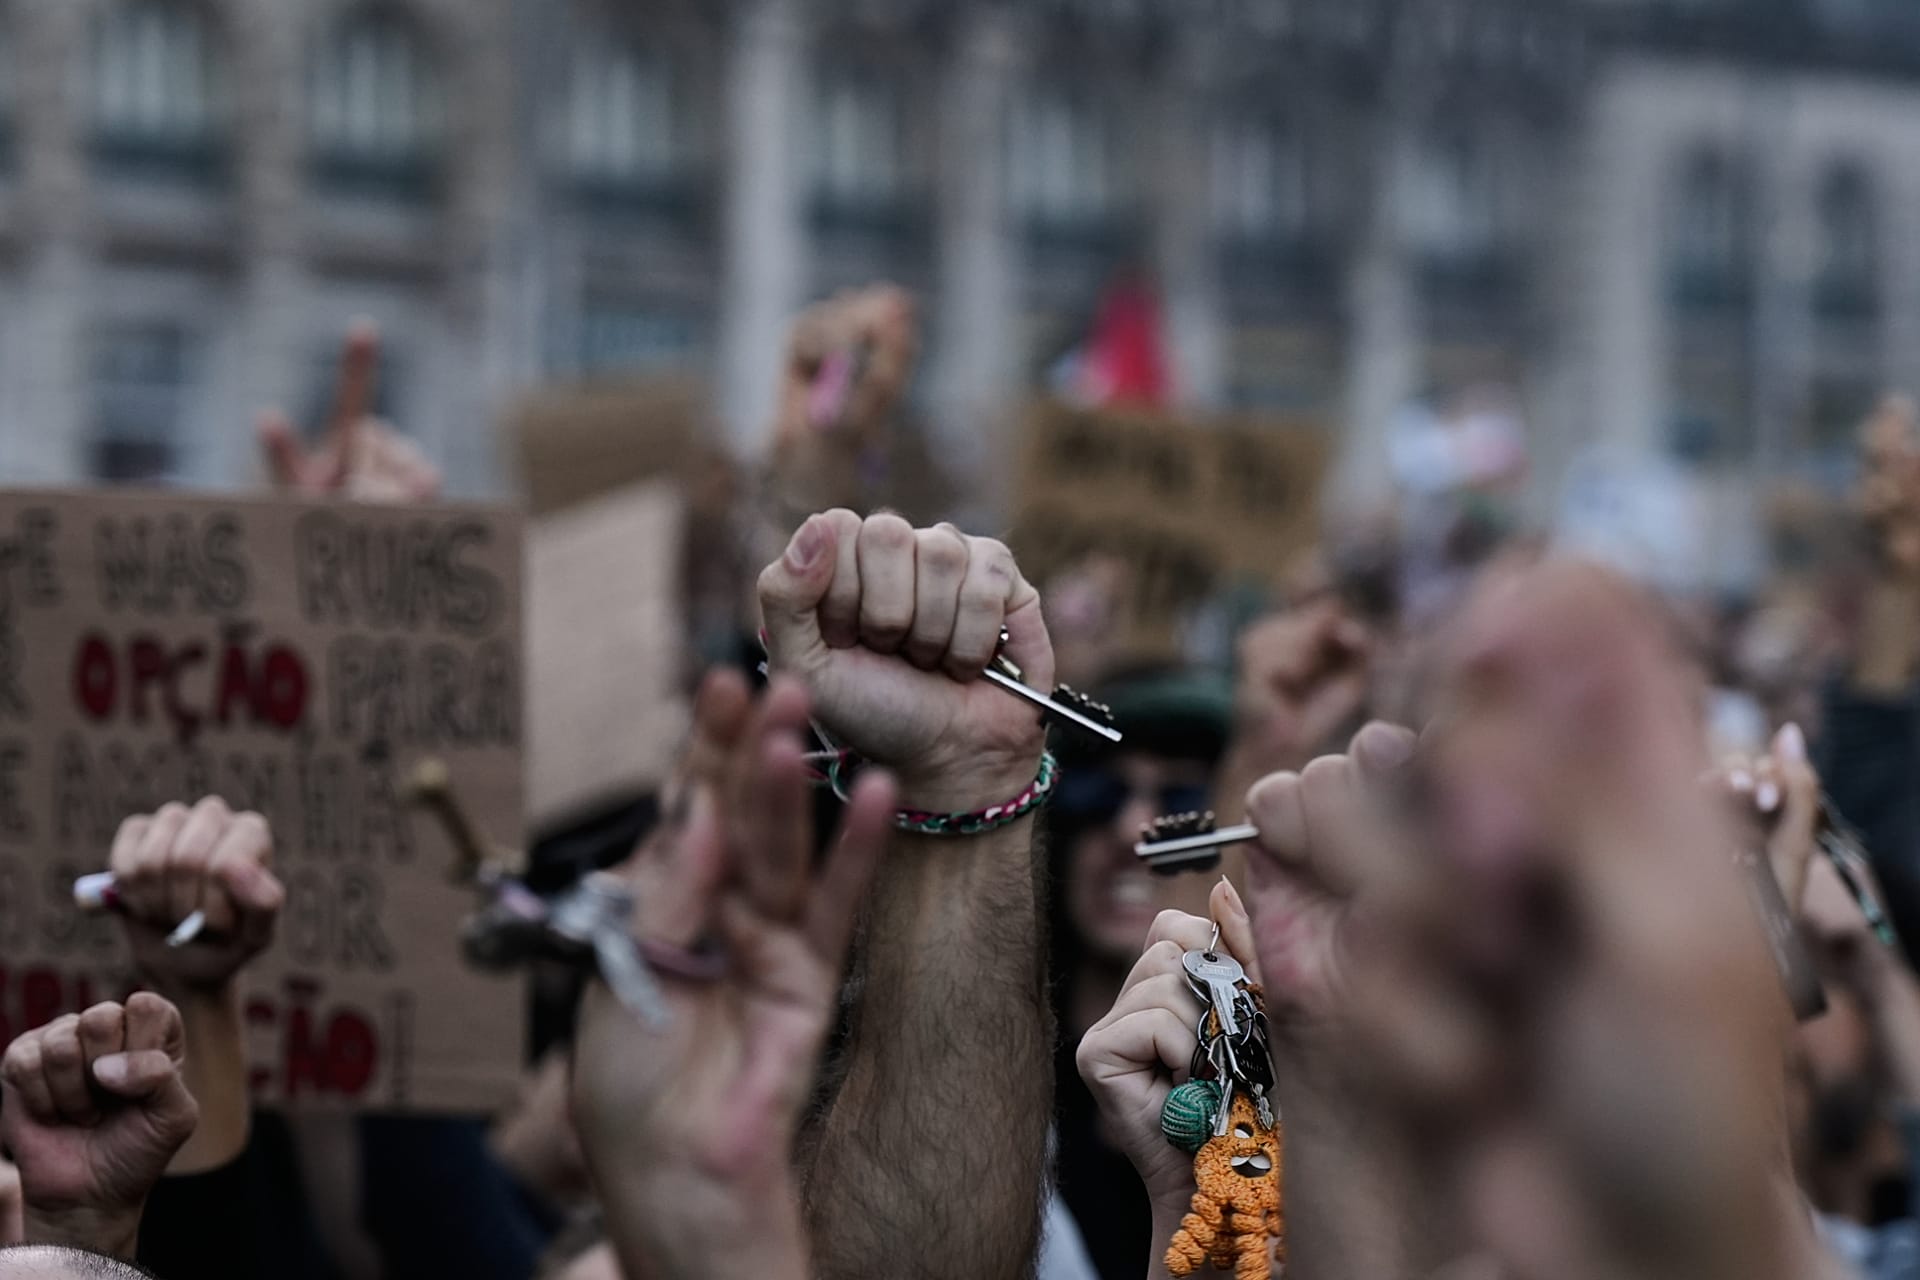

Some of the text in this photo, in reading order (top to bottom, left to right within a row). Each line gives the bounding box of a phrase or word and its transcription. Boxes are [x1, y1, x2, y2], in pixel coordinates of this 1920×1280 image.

[295, 509, 502, 635] RUAS
[71, 618, 313, 750] OPÇÃO
[328, 632, 518, 747] PARA
